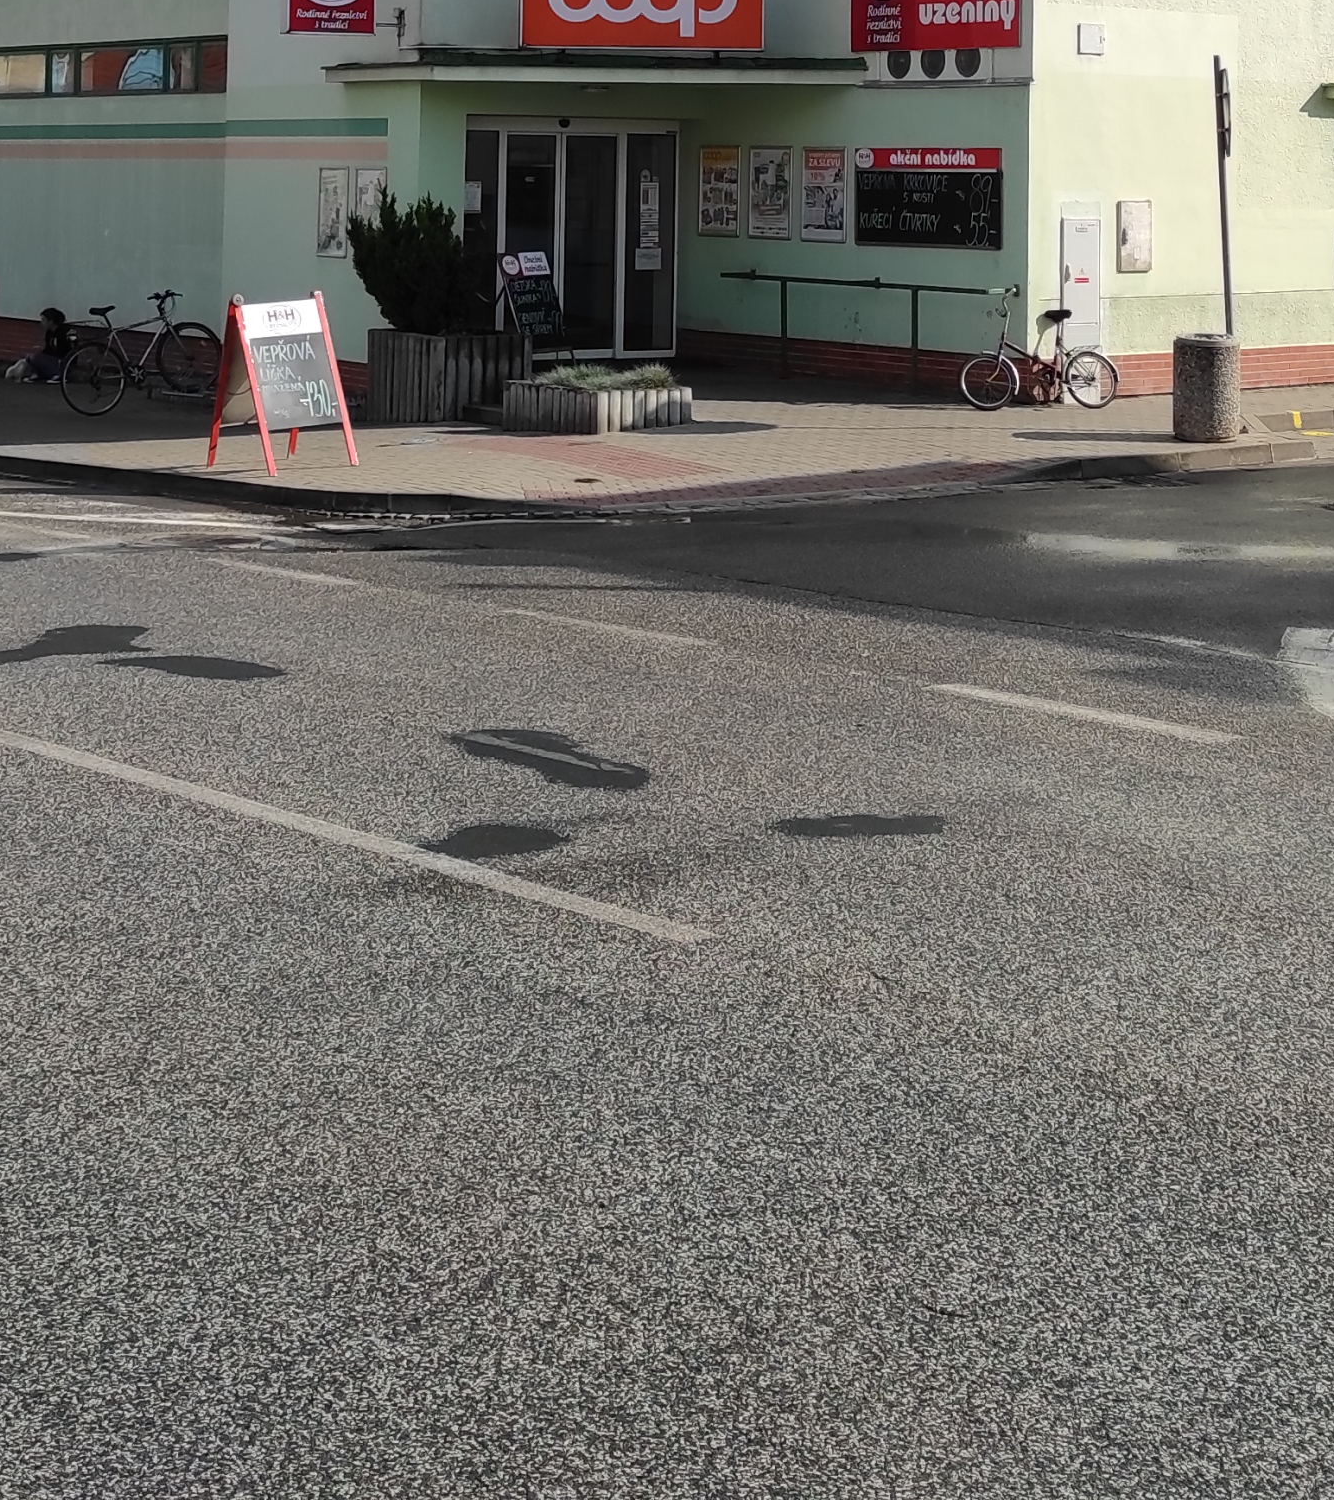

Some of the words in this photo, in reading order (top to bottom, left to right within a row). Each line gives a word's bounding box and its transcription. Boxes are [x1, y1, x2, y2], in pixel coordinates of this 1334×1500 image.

[296, 8, 330, 19] Rodinné
[867, 4, 901, 17] Rodinné
[314, 21, 319, 29] s
[867, 33, 872, 43] s
[873, 31, 901, 43] tradicí
[889, 149, 921, 165] akční
[924, 150, 976, 166] nabídka
[859, 207, 896, 230] KUŘECÍ
[899, 209, 941, 233] ČTVRTKY
[267, 308, 295, 322] H&H
[253, 335, 316, 363] VEPŘOVÁ
